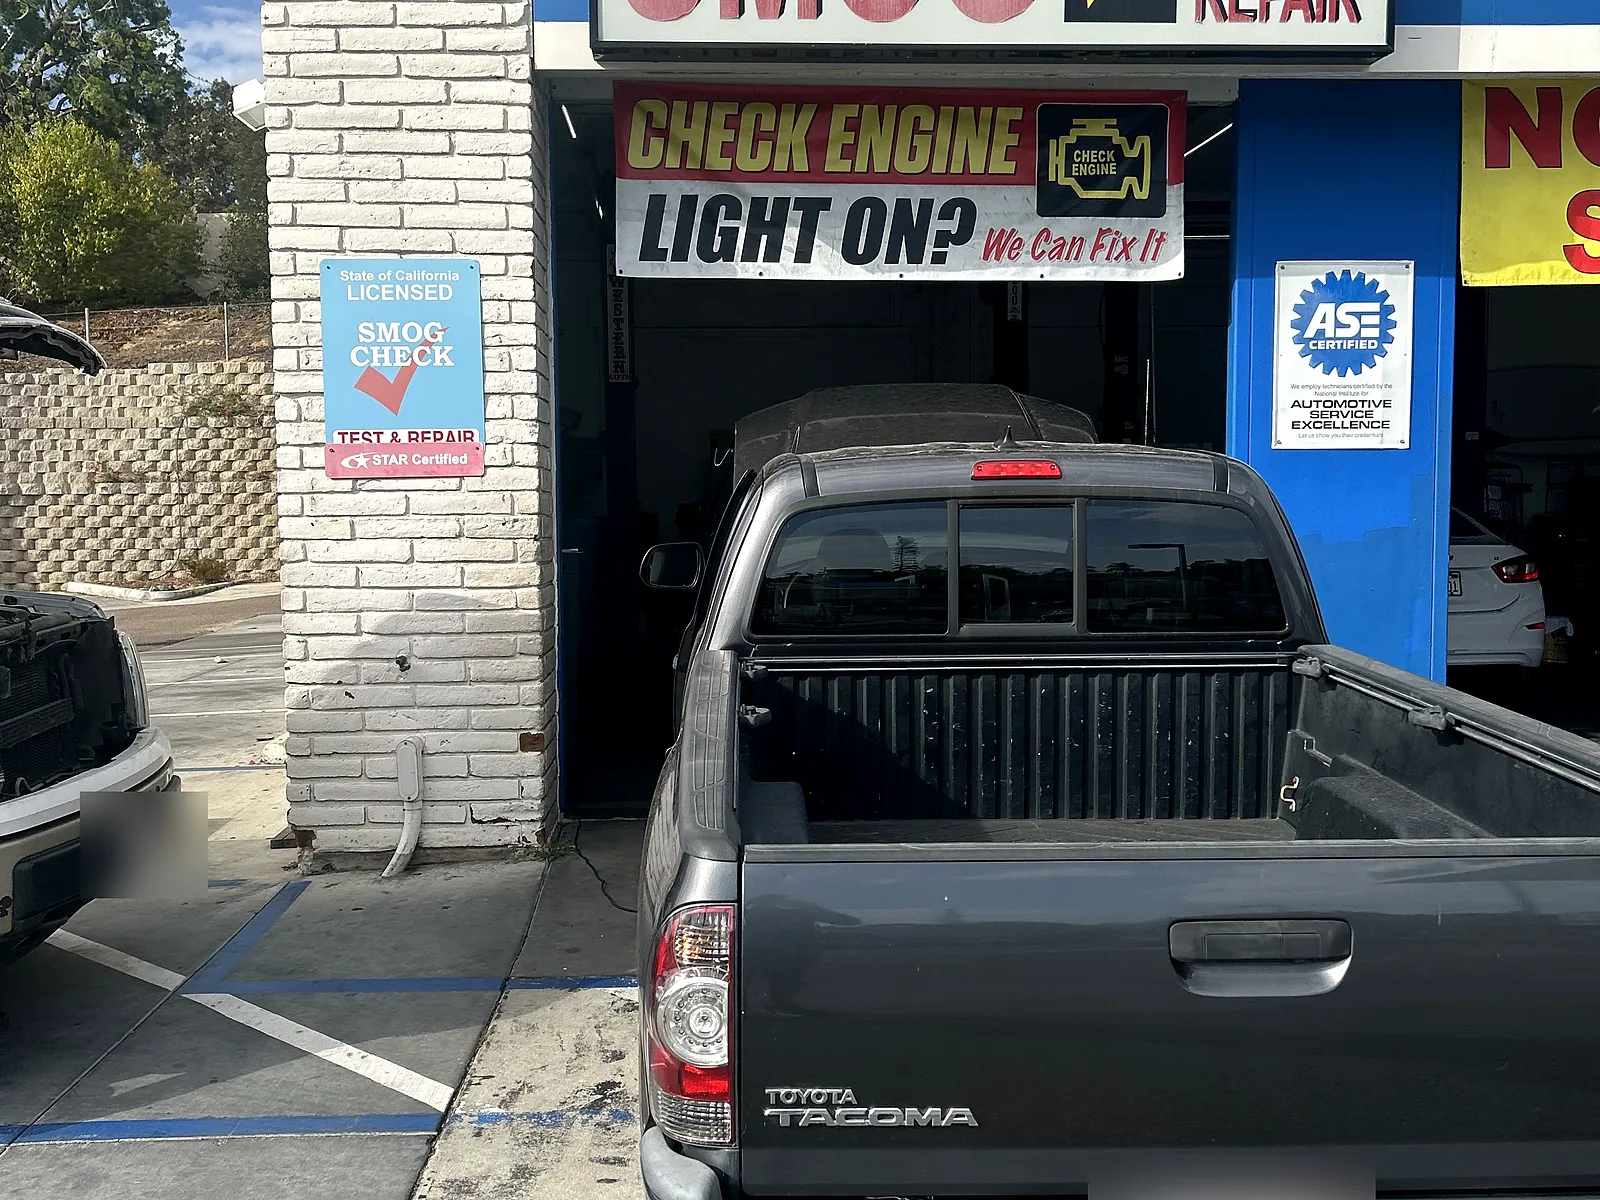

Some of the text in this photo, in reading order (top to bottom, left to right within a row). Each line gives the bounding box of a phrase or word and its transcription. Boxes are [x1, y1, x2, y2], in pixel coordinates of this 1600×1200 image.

[626, 98, 1025, 176] CHECK ENGINE
[1072, 149, 1116, 163] CHECK
[1071, 162, 1117, 176] ENGINE
[638, 193, 833, 264] LIGHT
[841, 196, 978, 265] ON?
[982, 227, 1169, 263] We Can Fix It
[340, 270, 460, 281] State of California
[347, 284, 453, 301] LICENSED
[1303, 302, 1381, 339] ASE
[358, 322, 445, 343] SMOG
[1309, 340, 1379, 350] CERTIFIED
[350, 346, 455, 367] CHECK
[1290, 399, 1392, 408] AUTOMOTIVE
[1310, 410, 1374, 418] SERVICE
[1291, 420, 1391, 429] EXCELLENCE
[338, 431, 384, 443] TEST
[407, 430, 475, 443] REPAIR
[372, 453, 468, 465] STAR Certified
[764, 1088, 858, 1105] TOYOTA
[763, 1107, 979, 1127] TACOMA
